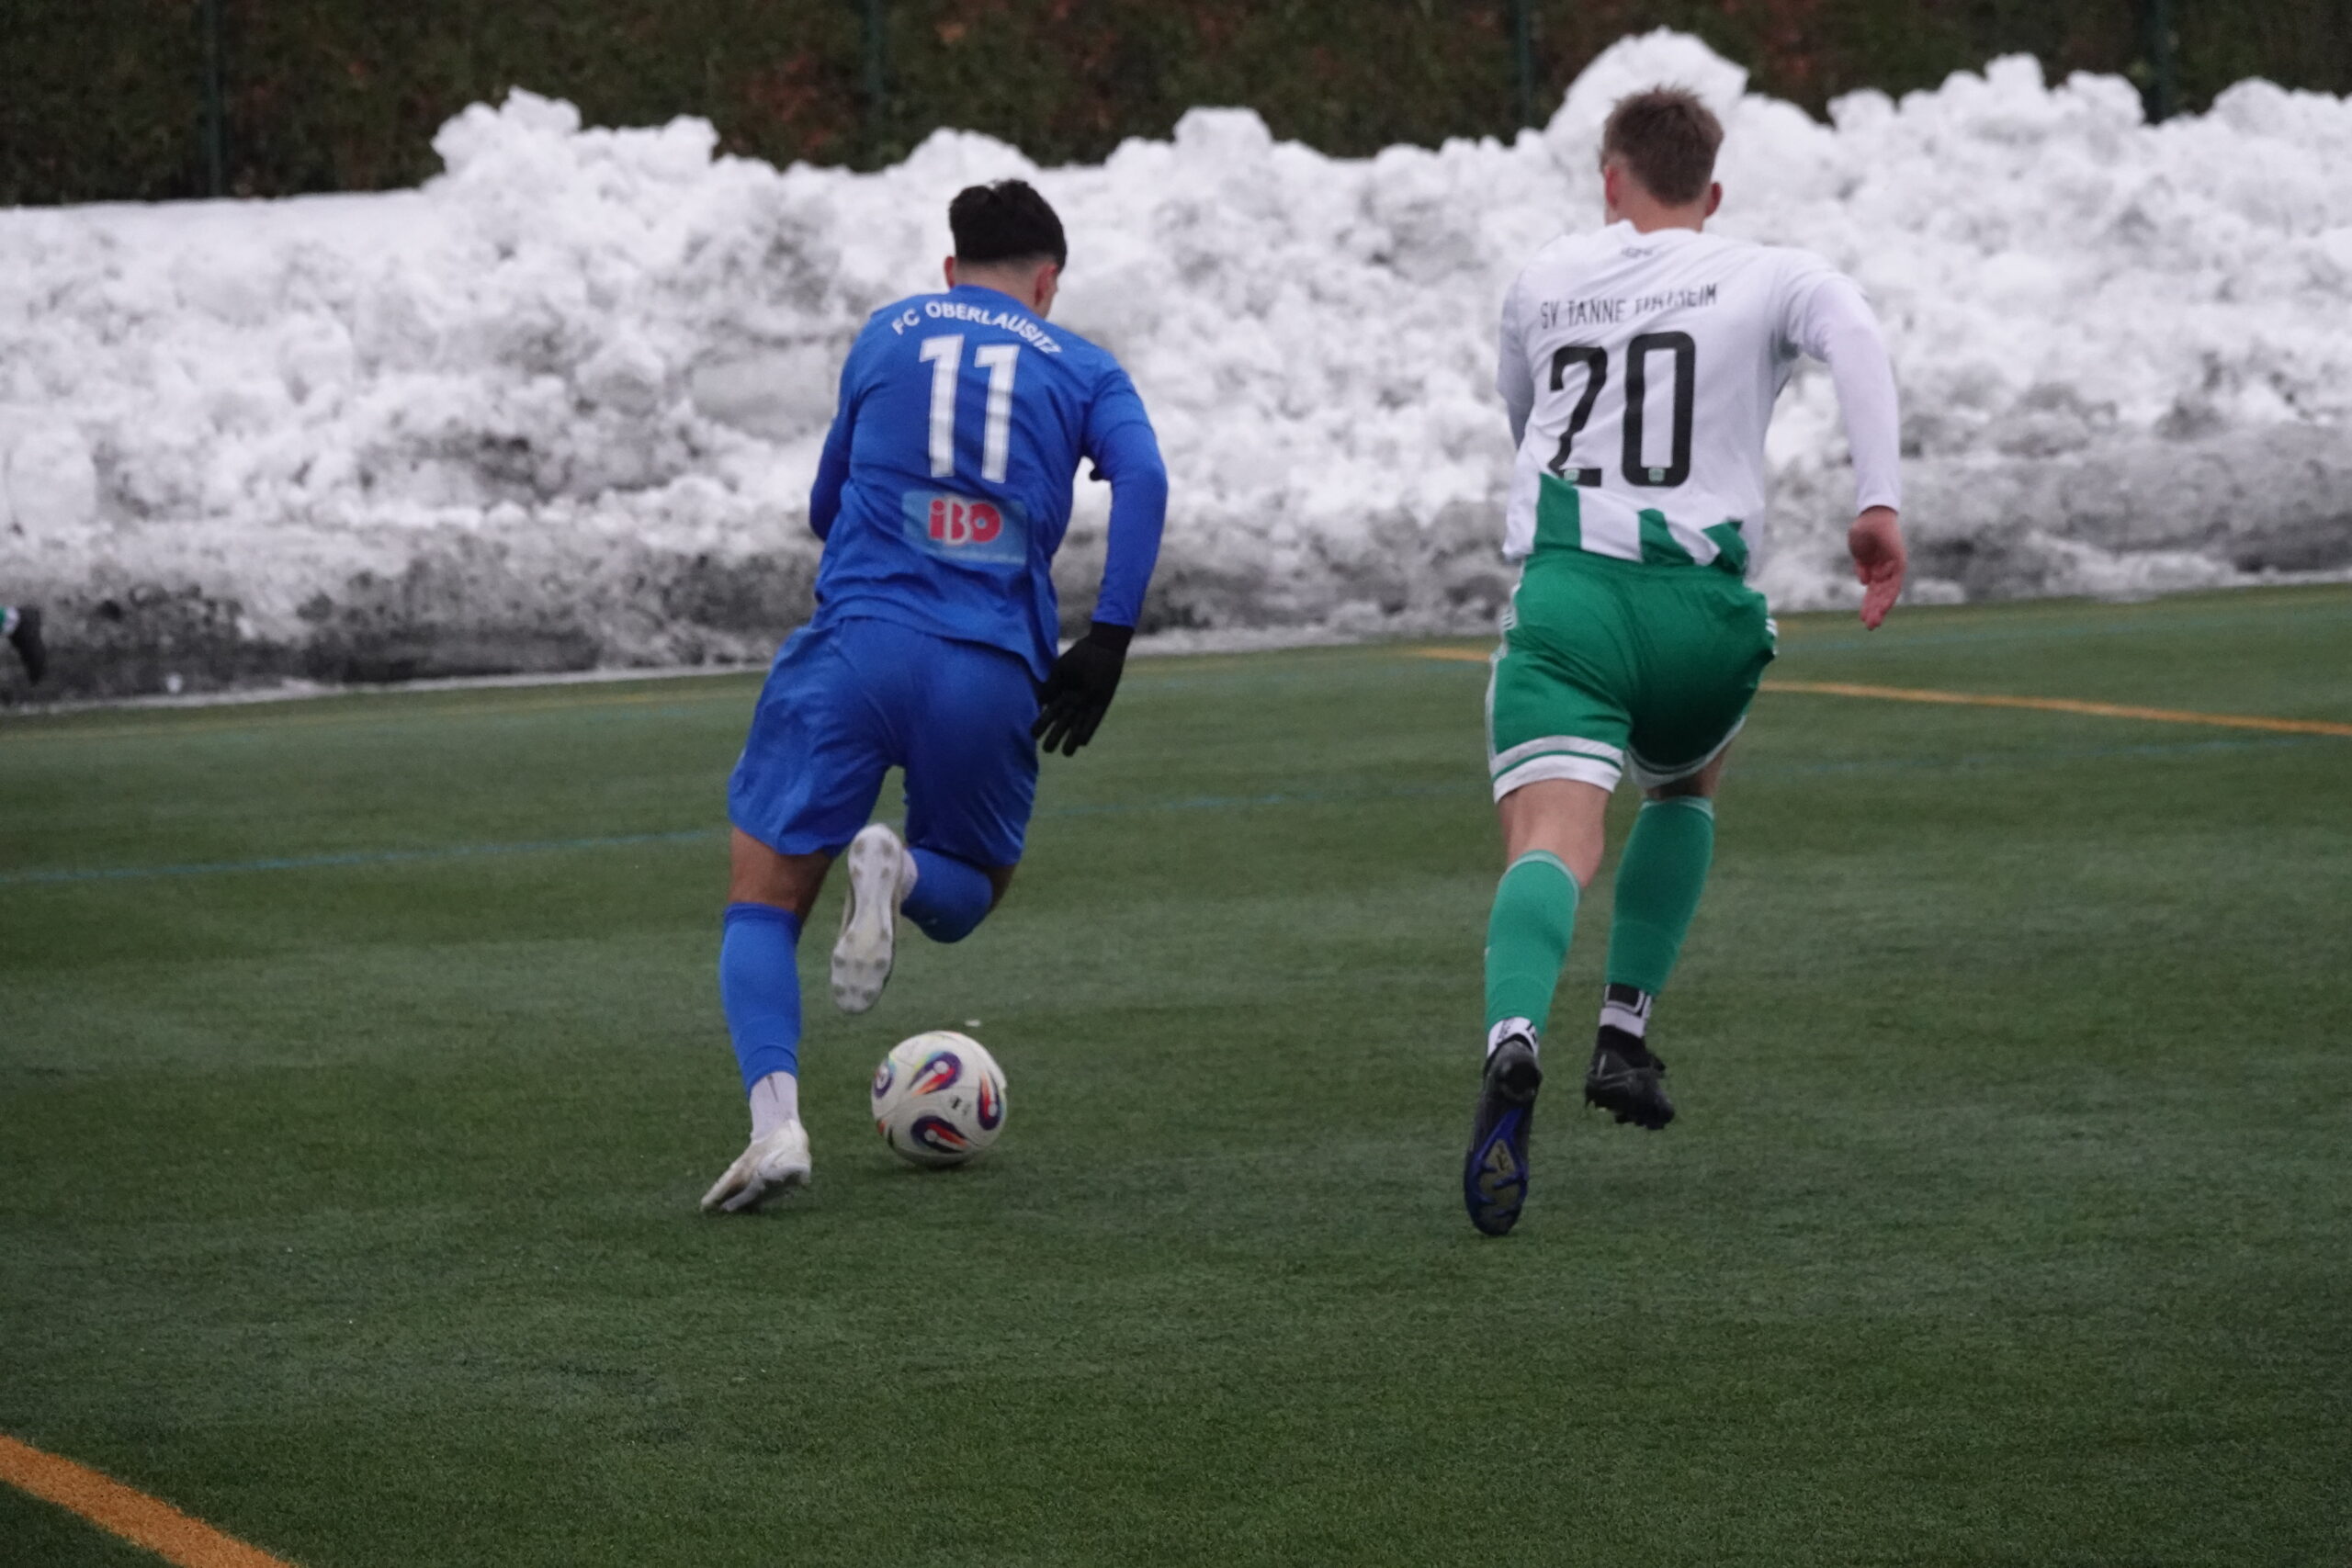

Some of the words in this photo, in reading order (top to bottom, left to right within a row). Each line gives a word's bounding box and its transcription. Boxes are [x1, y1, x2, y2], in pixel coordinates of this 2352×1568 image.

[891, 309, 920, 335] FC
[925, 301, 1062, 354] OBERLAUSITZ
[1540, 299, 1560, 329] SV
[920, 333, 1021, 484] 11
[1548, 332, 1695, 488] 20
